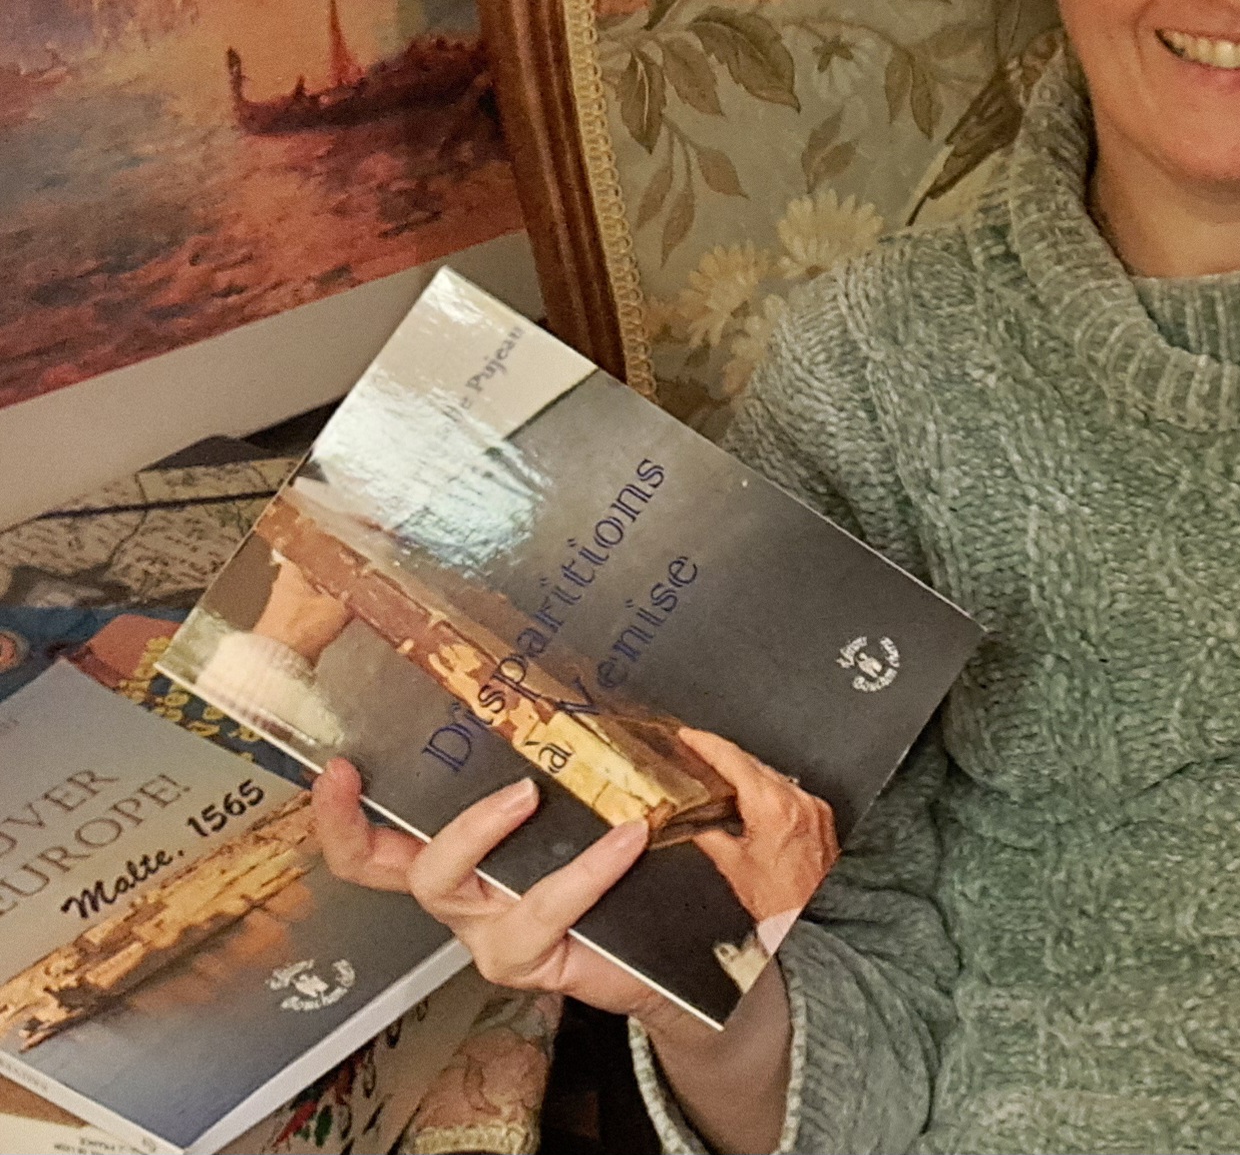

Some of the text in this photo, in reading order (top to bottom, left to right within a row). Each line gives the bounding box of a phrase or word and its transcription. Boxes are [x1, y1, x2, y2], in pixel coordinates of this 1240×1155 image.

[422, 458, 665, 772] Disparitions
[526, 556, 698, 775] à Venise
[186, 779, 266, 837] 1565
